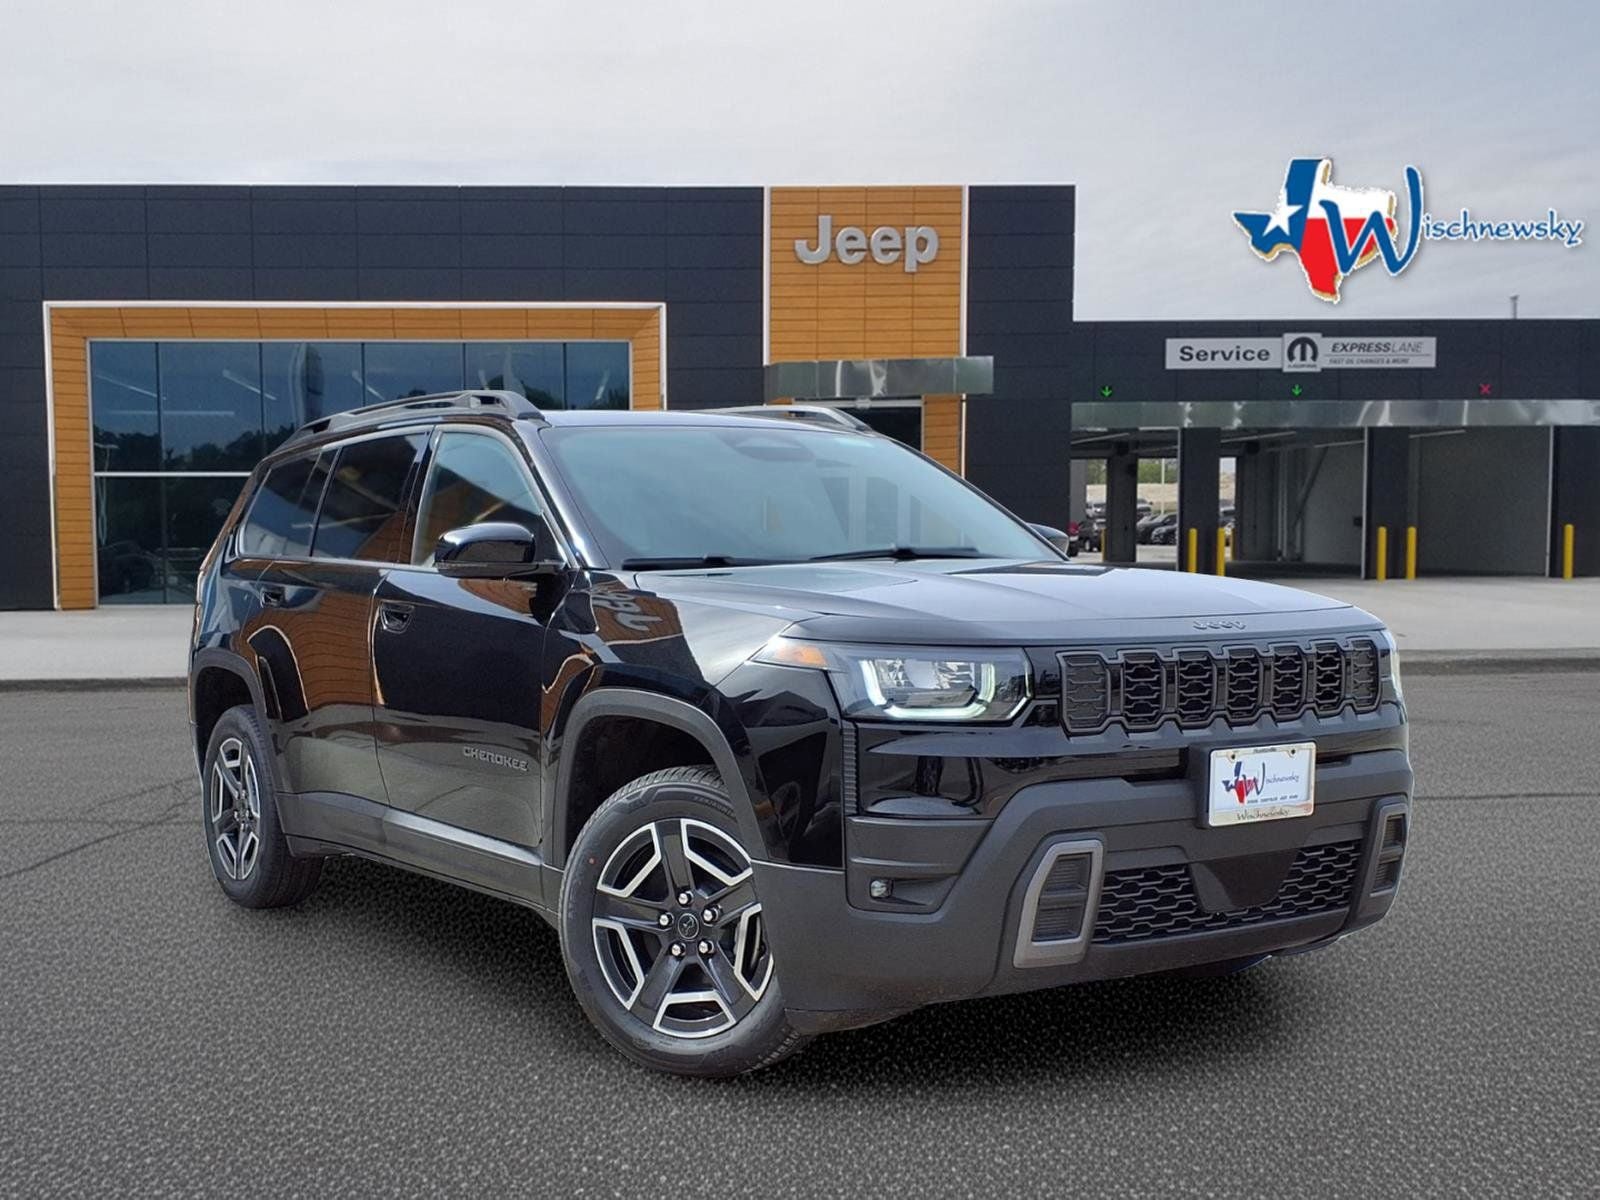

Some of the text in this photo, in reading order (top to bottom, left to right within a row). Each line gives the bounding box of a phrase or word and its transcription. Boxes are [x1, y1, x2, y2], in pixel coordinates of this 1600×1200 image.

[794, 214, 939, 273] Jeep
[1179, 345, 1271, 362] Service
[463, 746, 529, 772] CHEROKEE
